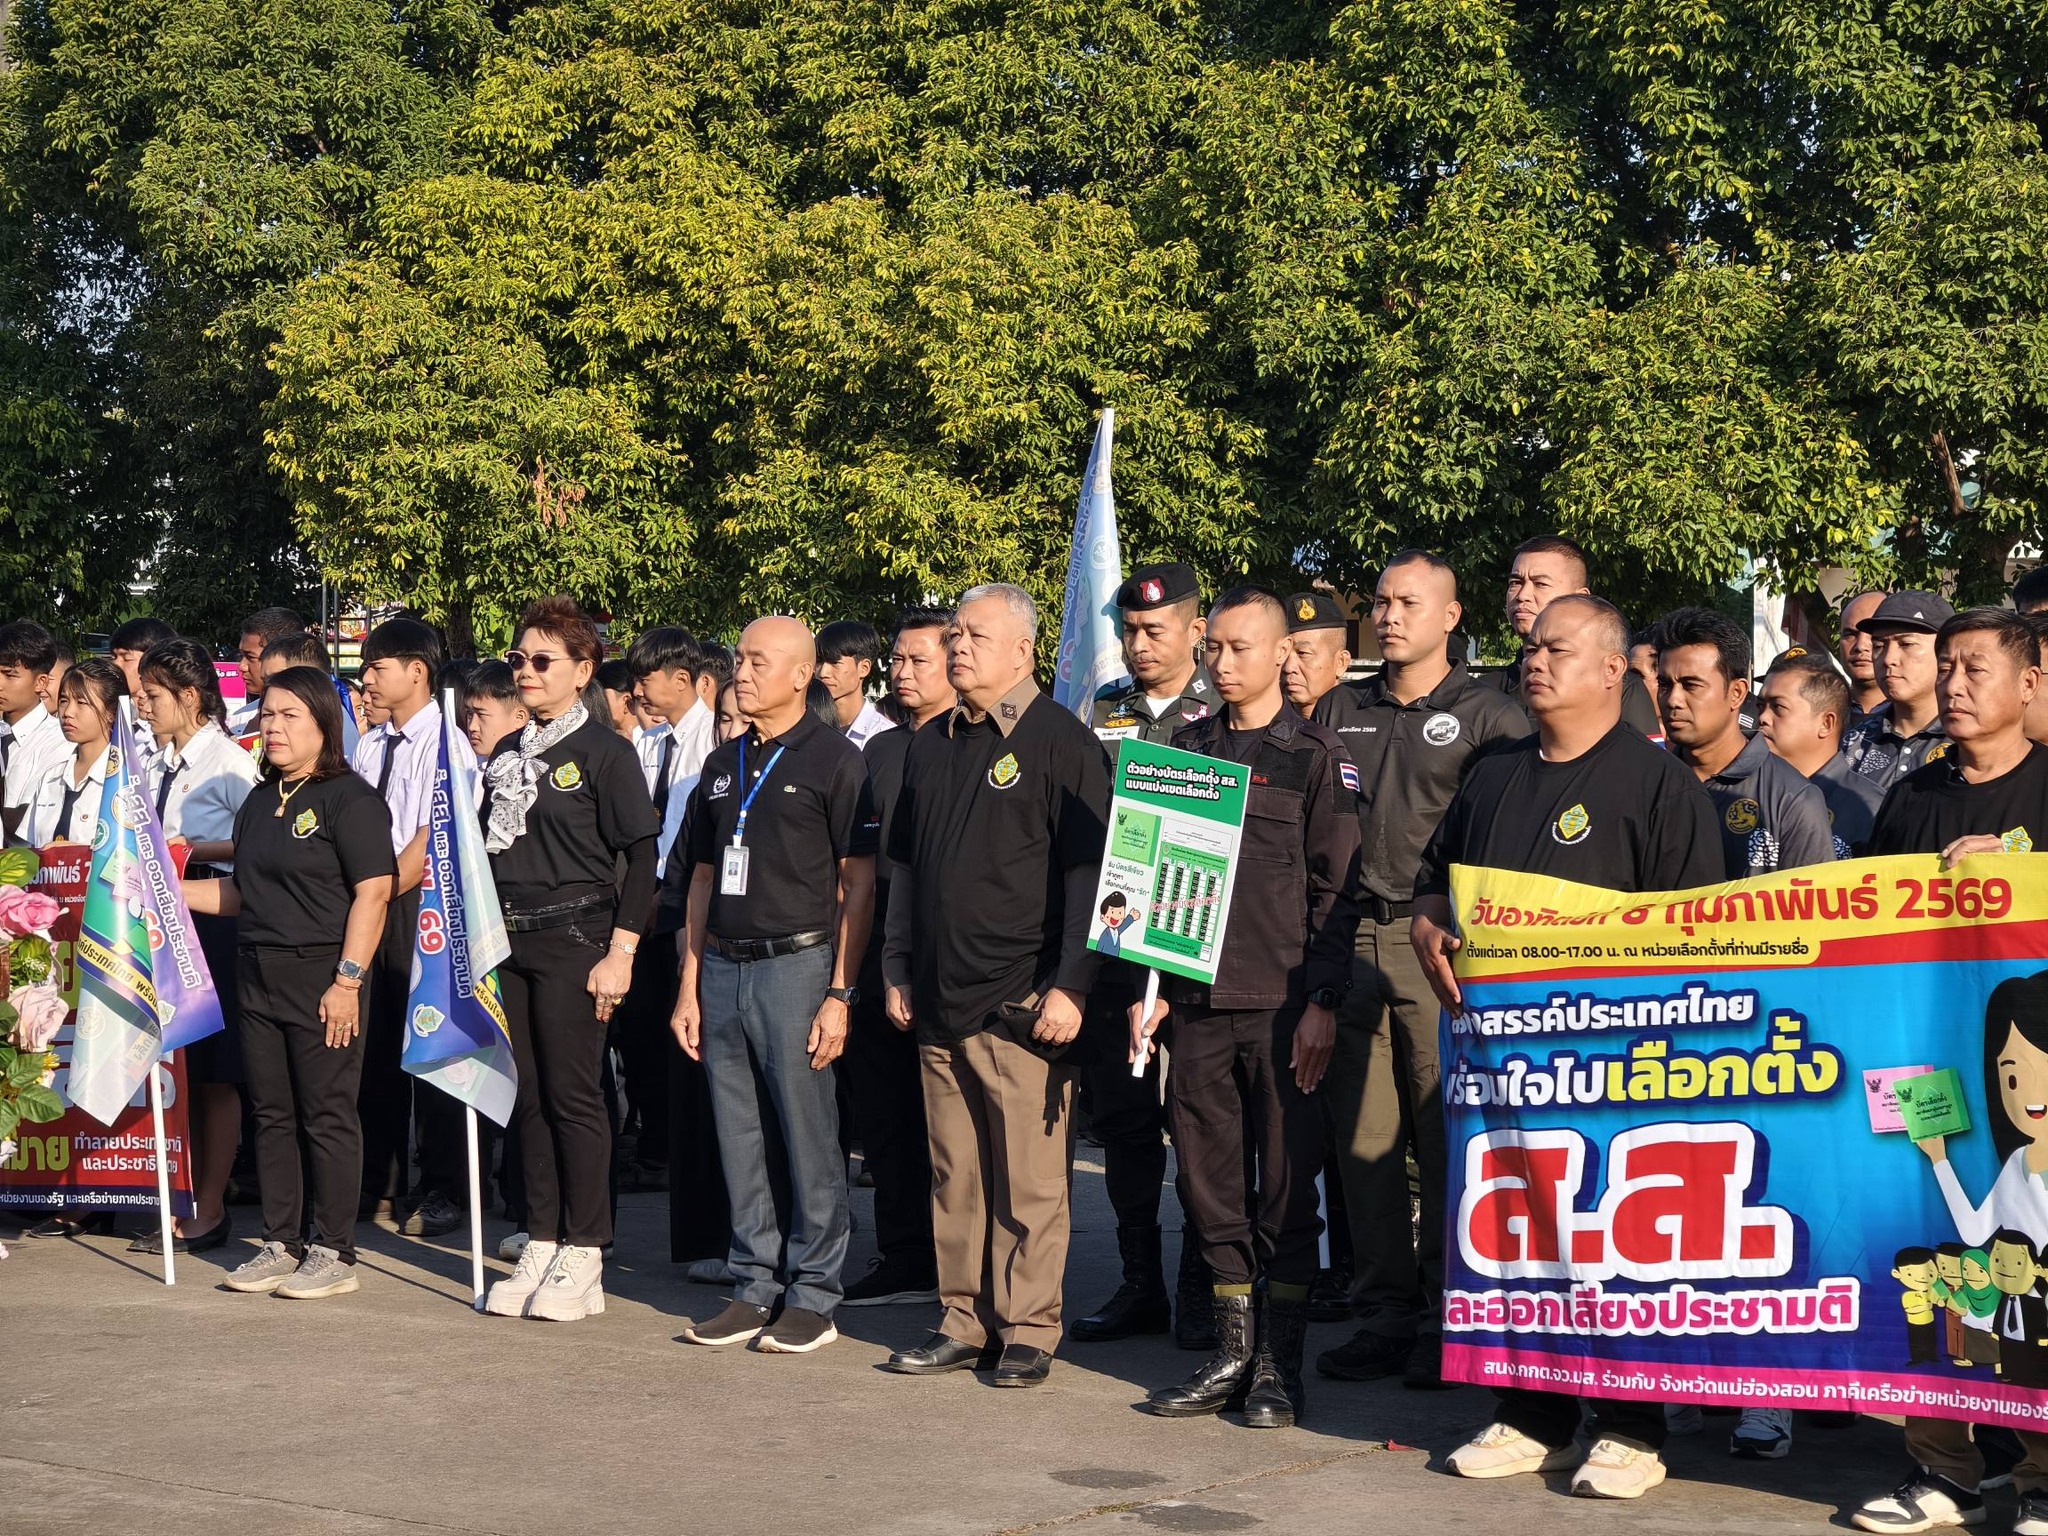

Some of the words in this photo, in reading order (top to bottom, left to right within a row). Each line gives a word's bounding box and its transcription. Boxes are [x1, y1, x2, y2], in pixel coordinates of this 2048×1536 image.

[1125, 779, 1220, 799] แบบแบ่งเขตเลือกตั้ง
[1126, 761, 1220, 784] ตัวอย่างบัตรเลือกตั้ง
[1220, 776, 1238, 787] สส.
[1665, 872, 1881, 936] กุมภาพันธ์
[1895, 877, 2013, 919] 2569
[417, 909, 444, 953] 69
[440, 860, 472, 997] ออกเสียงประชามต
[1466, 941, 1518, 959] ตั้งแต่เวลา
[1521, 945, 1603, 959] 08.00-17.00
[1606, 947, 1620, 957] น.
[1624, 946, 1637, 957] ณ
[1642, 937, 1809, 957] หน่วยเลือกตั้งที่ท่านมีรายชื่อ
[74, 1131, 182, 1153] ทำลายประเทชาติ
[1468, 1140, 1776, 1264] ส.ส.
[1484, 1361, 1598, 1386] สนง.กกต.จว.มส.
[1602, 1370, 1655, 1390] ร่วมกับ
[1659, 1373, 1818, 1398] จังหวัดแม่ฮ่องสอน
